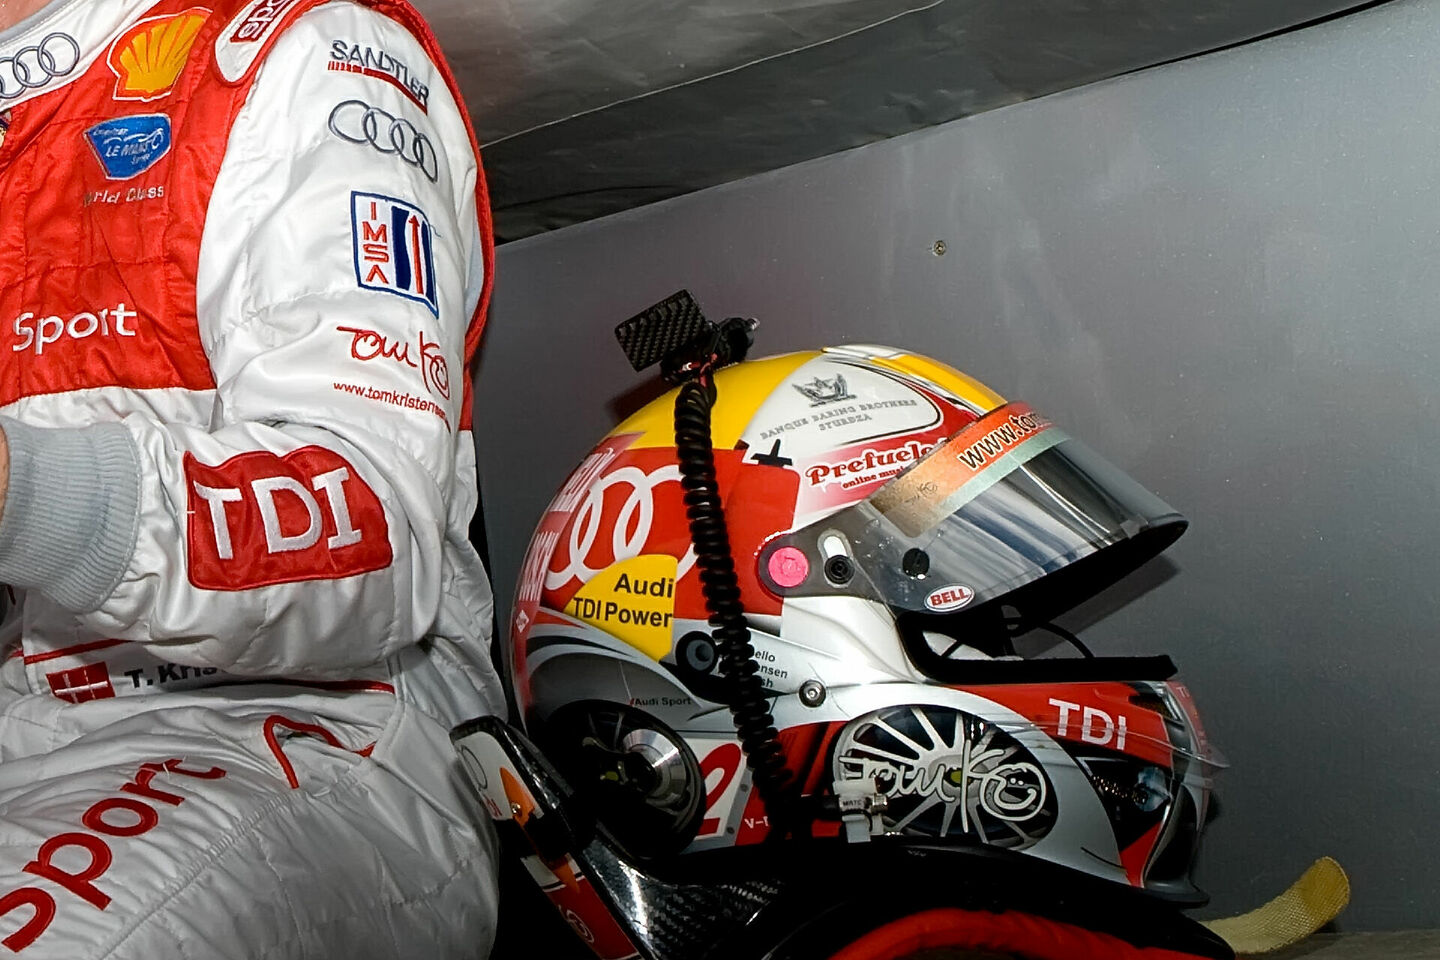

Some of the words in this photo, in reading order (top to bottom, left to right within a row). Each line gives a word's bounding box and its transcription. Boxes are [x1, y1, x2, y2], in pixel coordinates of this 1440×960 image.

[329, 40, 430, 108] SANDTLER
[106, 146, 120, 157] LE
[12, 303, 137, 355] Sport
[760, 418, 809, 440] BANQUE
[811, 405, 857, 422] BARING
[860, 399, 918, 412] BROTHERS
[818, 414, 873, 431] STURDZA
[842, 474, 877, 489] online
[191, 466, 363, 560] TDI
[614, 573, 675, 598] Audi
[930, 588, 969, 606] BELL
[573, 597, 601, 620] TDI
[605, 602, 673, 628] Power
[124, 668, 154, 689] T.
[635, 697, 659, 706] Audi
[661, 696, 691, 707] Sport
[1049, 698, 1127, 751] TDI
